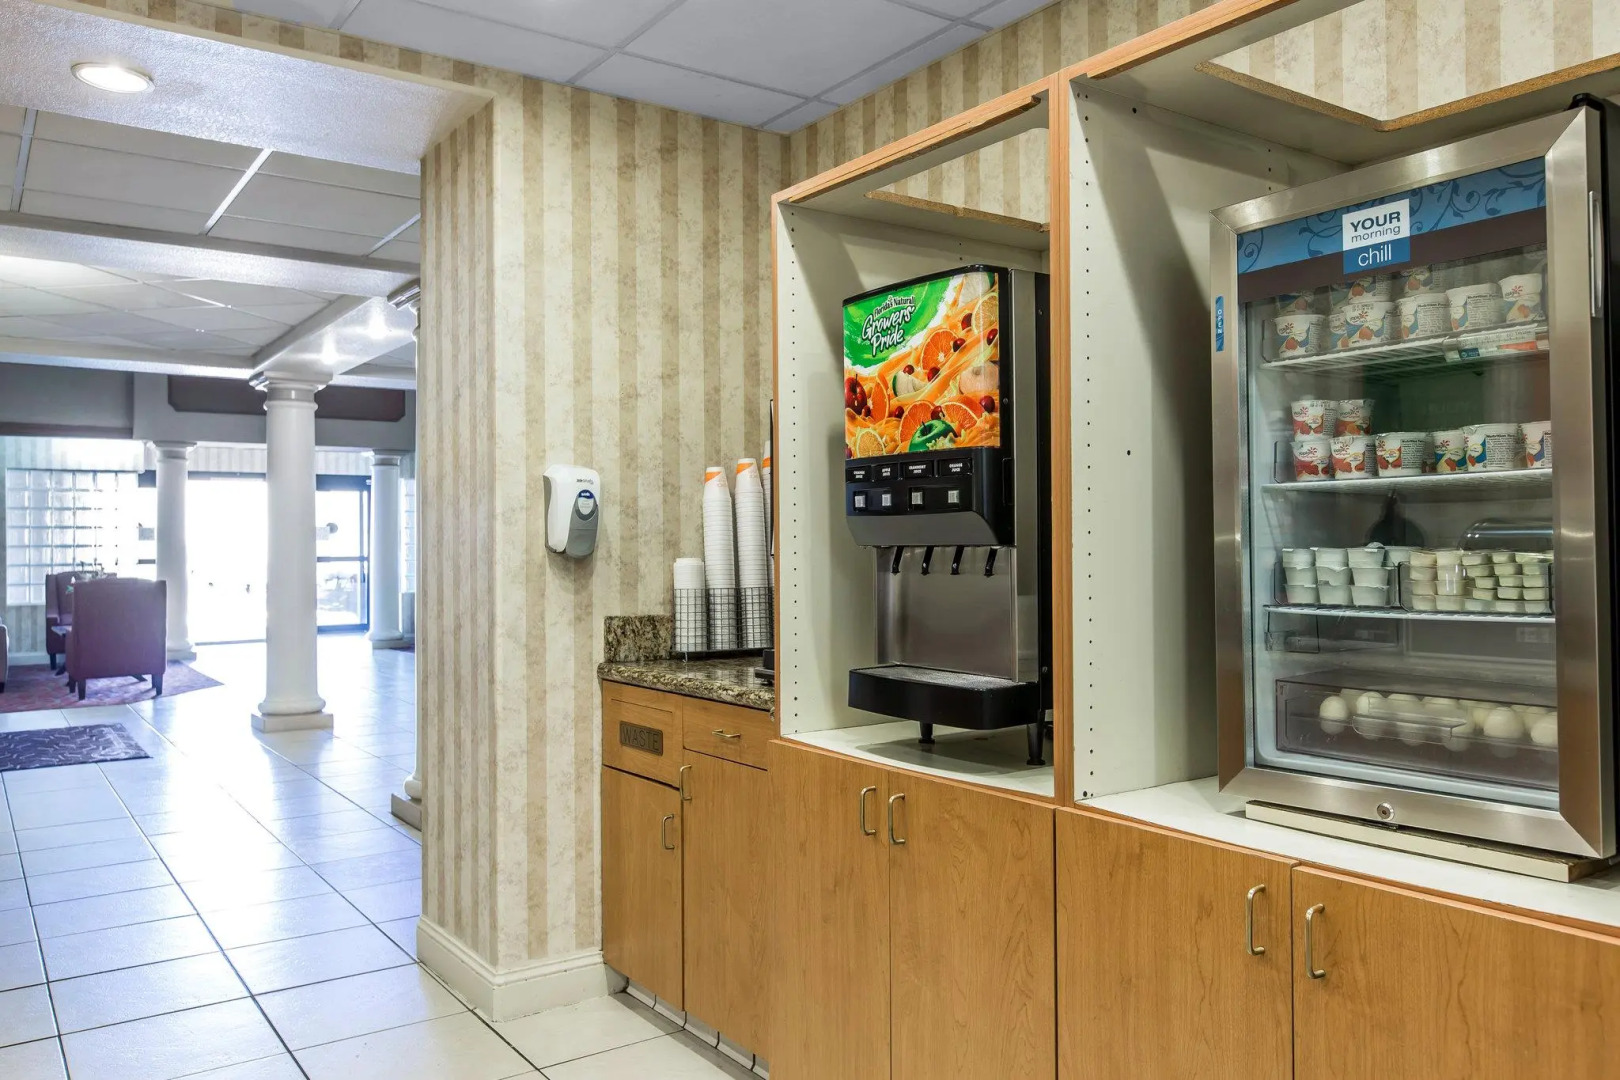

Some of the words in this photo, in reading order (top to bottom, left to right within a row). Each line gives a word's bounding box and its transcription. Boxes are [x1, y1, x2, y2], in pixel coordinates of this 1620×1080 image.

[1350, 211, 1401, 233] YOUR
[1351, 225, 1401, 243] morning
[1358, 243, 1392, 267] chill
[893, 294, 914, 307] Natural
[862, 306, 915, 340] Growers'
[871, 325, 904, 357] Pride
[622, 725, 660, 752] WASTE
